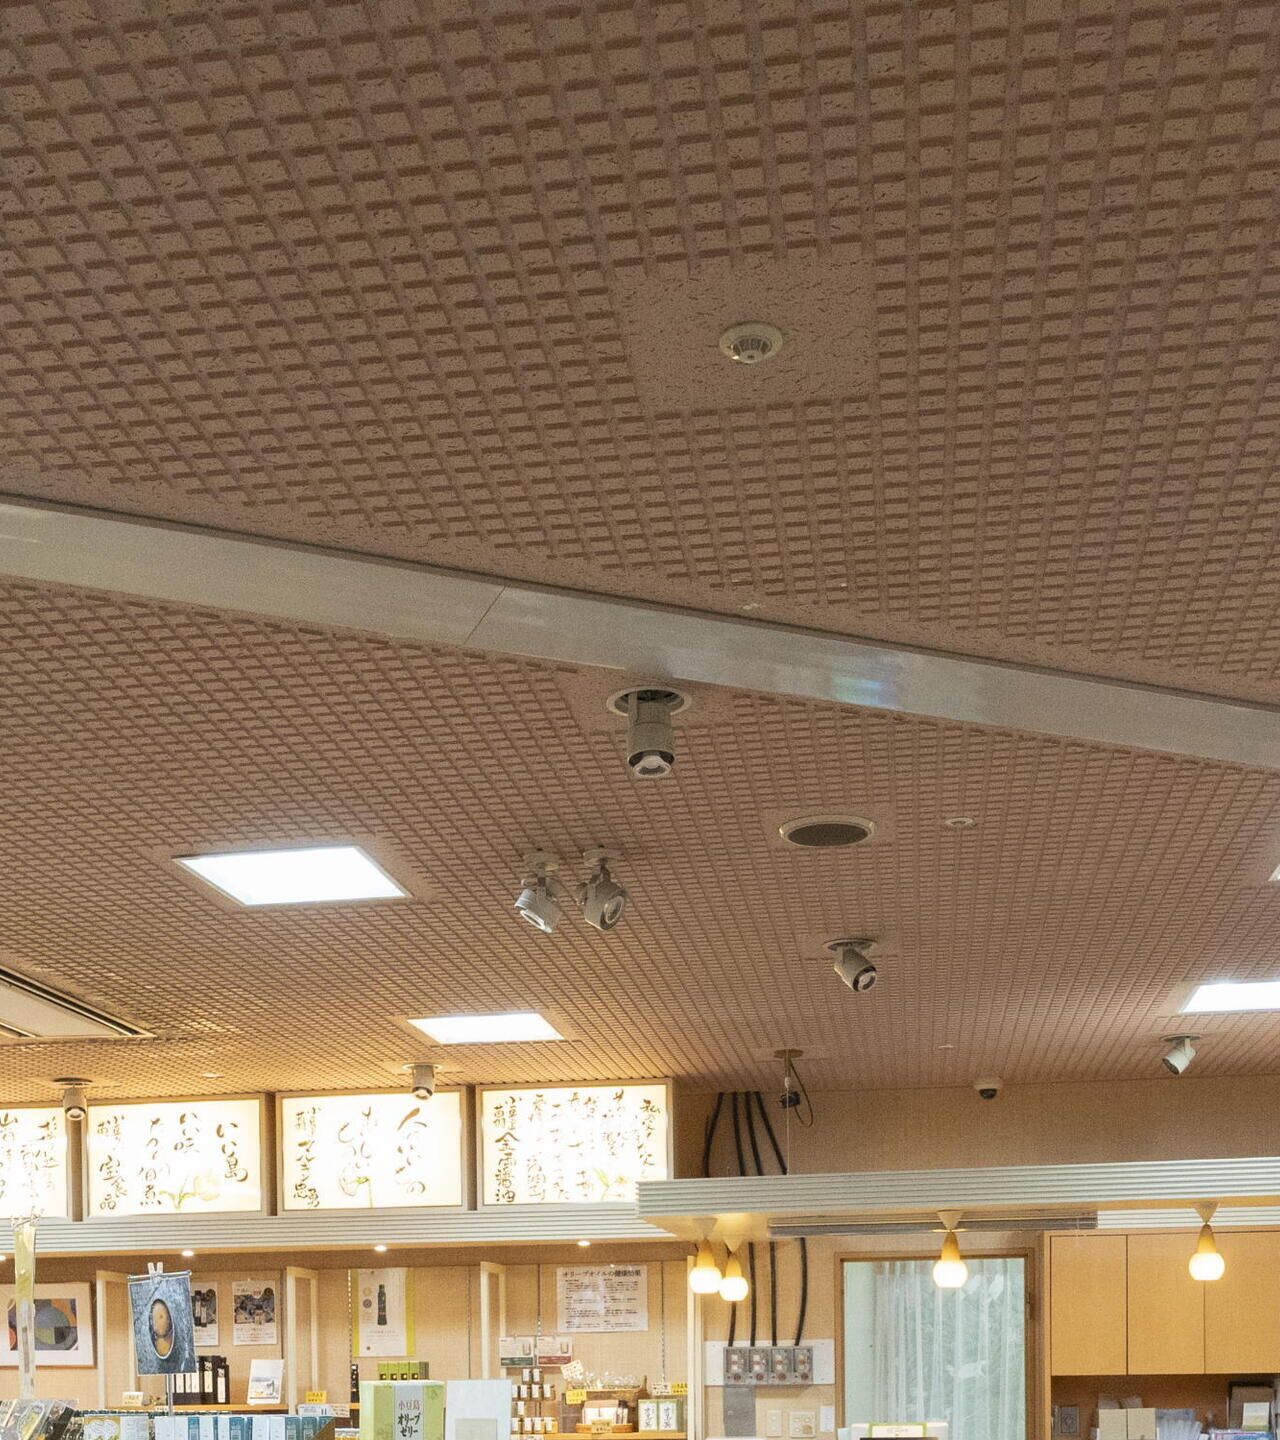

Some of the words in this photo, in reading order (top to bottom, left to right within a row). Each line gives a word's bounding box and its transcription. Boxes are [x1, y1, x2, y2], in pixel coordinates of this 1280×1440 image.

[397, 1412, 421, 1426] オリーブ
[399, 1425, 419, 1438] ゼリー
